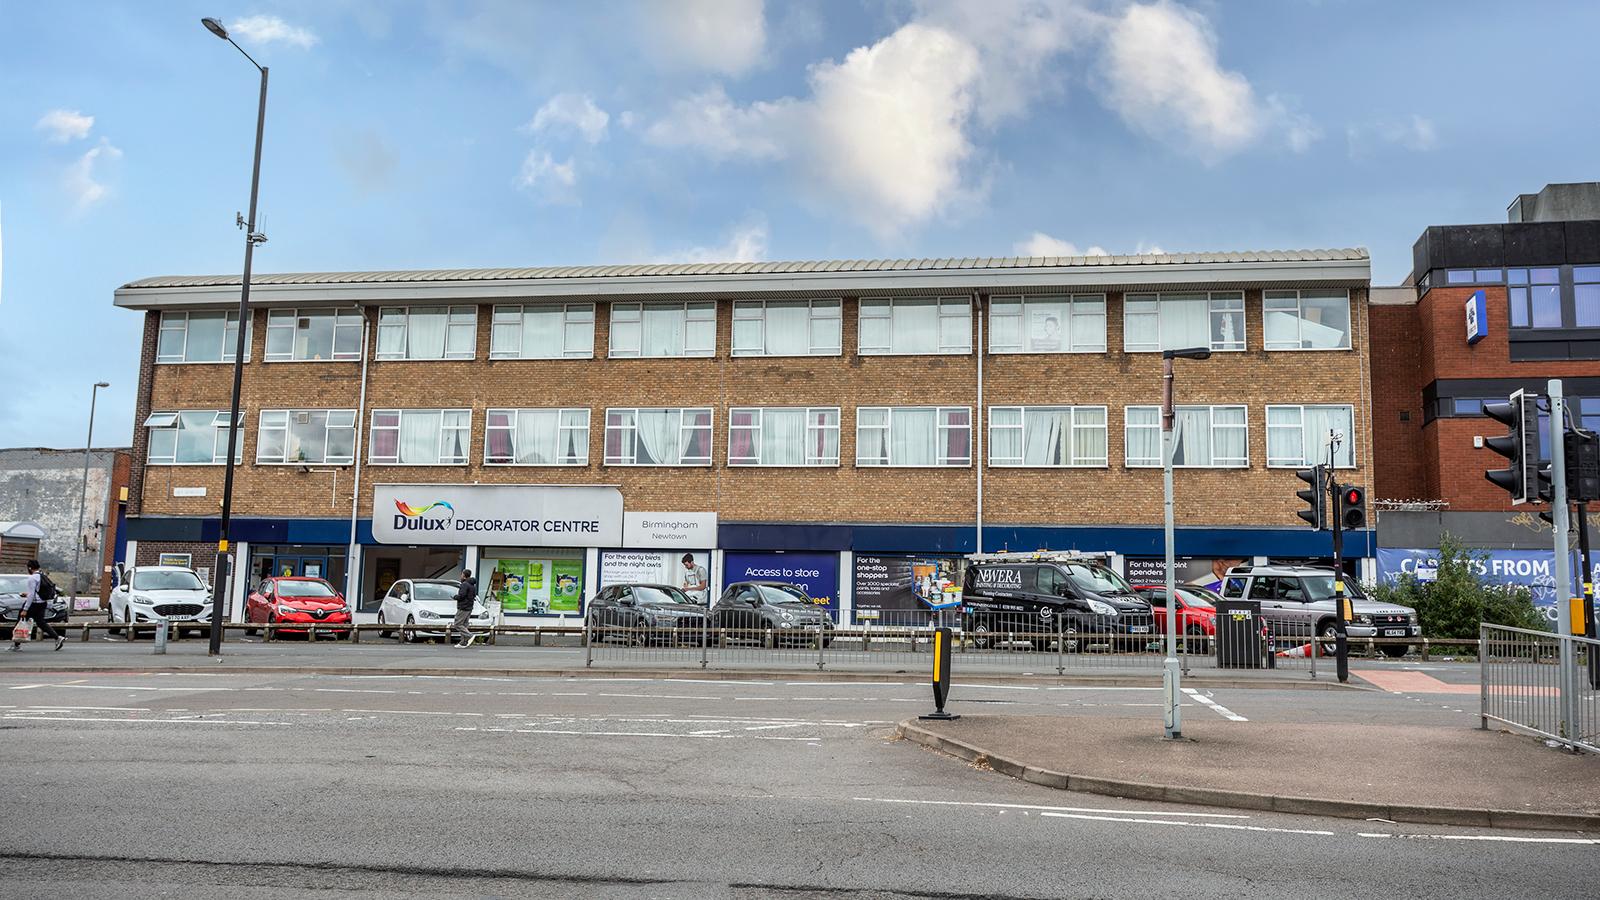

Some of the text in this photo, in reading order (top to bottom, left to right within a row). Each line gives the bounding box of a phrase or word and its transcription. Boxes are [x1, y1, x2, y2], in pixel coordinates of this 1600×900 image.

[394, 514, 599, 533] Dulux DECORATOR CENTRE
[642, 520, 698, 530] Birmingham
[1156, 561, 1167, 569] big
[1492, 559, 1550, 576] FROM
[745, 567, 820, 578] Access to store
